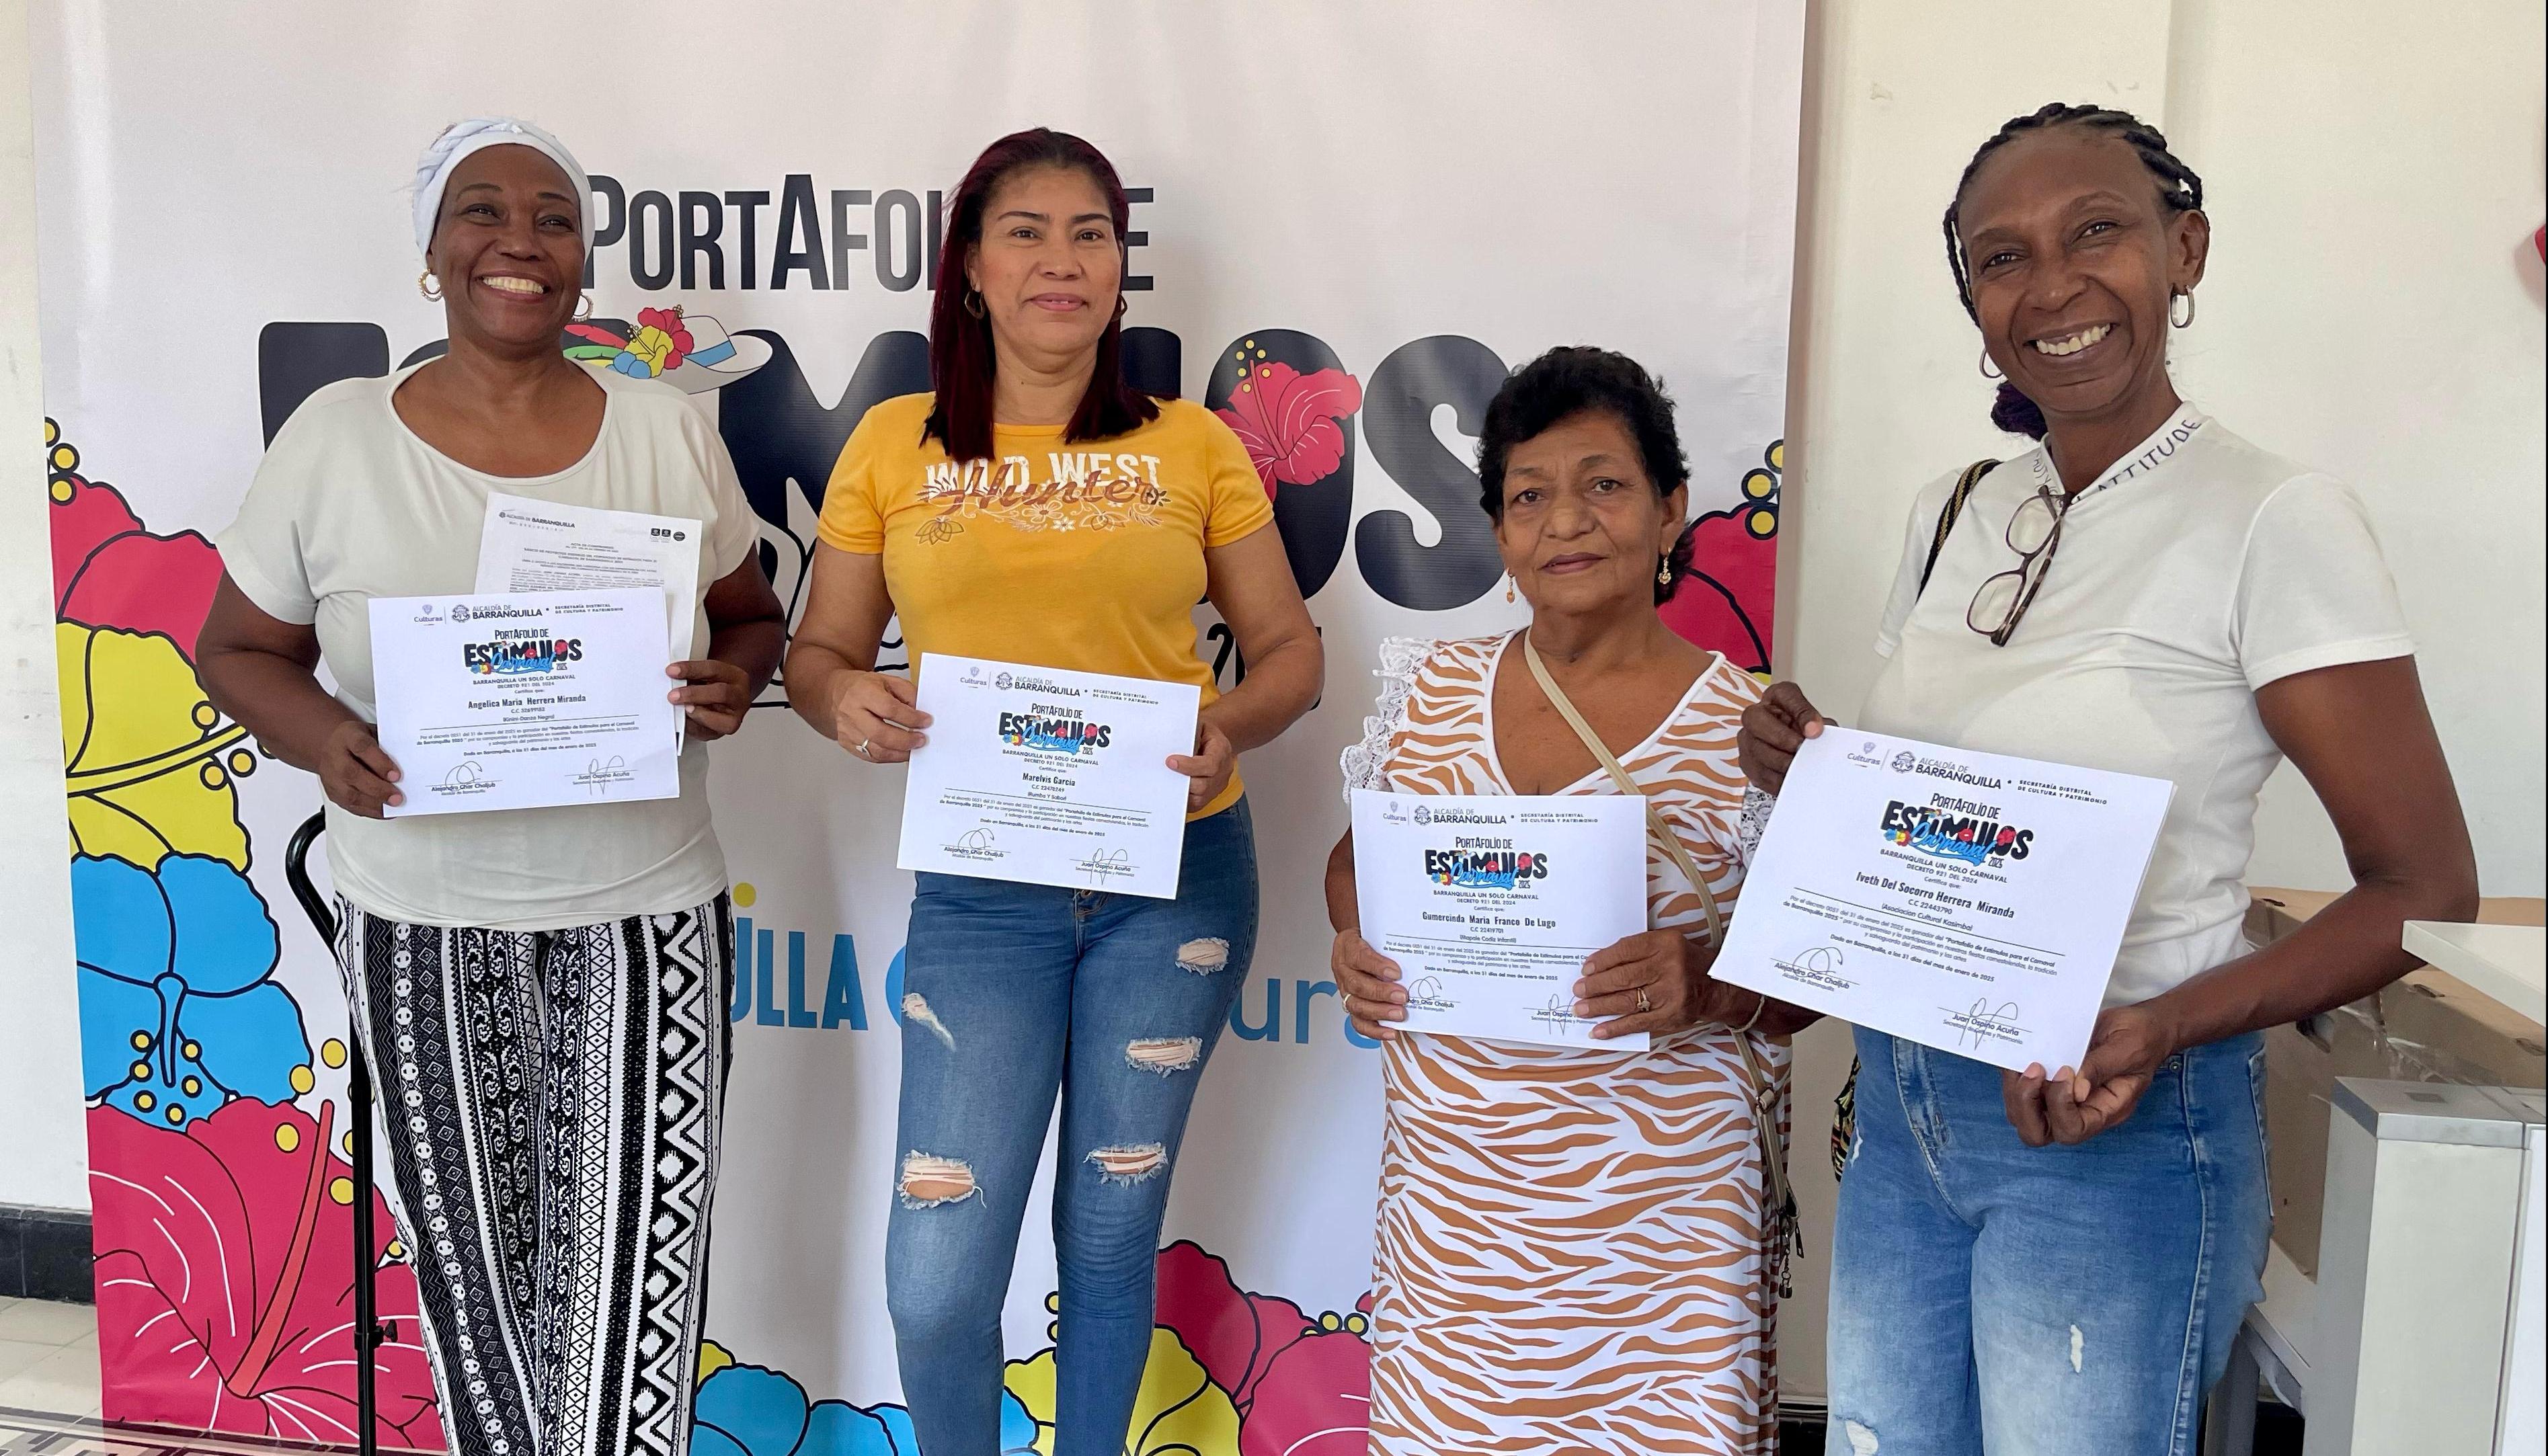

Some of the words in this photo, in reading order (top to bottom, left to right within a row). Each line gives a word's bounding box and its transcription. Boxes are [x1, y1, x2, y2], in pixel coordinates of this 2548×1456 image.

[583, 173, 943, 292] PORTAFO
[2098, 419, 2202, 491] ATTITUDE
[925, 455, 1030, 499] WILD
[1047, 452, 1160, 489] WEST
[939, 463, 1158, 516] Hunter
[471, 603, 502, 612] ALCALDÍA
[472, 608, 543, 619] BARRANQUILLA
[539, 628, 549, 637] DE
[959, 676, 987, 686] Culturas
[1014, 676, 1043, 685] ALCALDÍA
[1014, 681, 1080, 697] BARRANQUILLA
[467, 700, 500, 710] Angelica
[502, 698, 522, 706] Maria
[526, 696, 555, 704] Herrera
[557, 694, 586, 703] Miranda
[1073, 709, 1083, 719] DE
[1002, 748, 1043, 758] BARRANQUILLA
[1070, 757, 1099, 766] CARNAVAL
[1847, 752, 1880, 765] Culturas
[1917, 757, 1955, 770] ALCALDÍA
[1955, 764, 1969, 773] DE
[1022, 772, 1051, 783] Marelvis
[1915, 763, 2001, 789] BARRANQUILLA
[2019, 779, 2057, 790] SECRETARÍA
[2058, 786, 2092, 796] DISTRITAL
[2027, 787, 2057, 796] CULTURA
[2065, 793, 2107, 805] PATRIMONIO
[1382, 812, 1406, 821] Culturas
[1433, 807, 1464, 815] ALCALDÍA
[1433, 813, 1507, 824] BARRANQUILLA
[1986, 805, 2001, 819] DE
[1502, 838, 1513, 849] DE
[1909, 821, 1999, 866] Carnaval
[1880, 848, 1933, 866] BARRANQUILLA
[1934, 861, 1947, 869] UN
[1948, 864, 1968, 874] SOLO
[1968, 869, 2007, 883] CARNAVAL
[1987, 856, 2005, 868] 2025
[1905, 862, 1934, 874] DECRETO
[1948, 873, 1960, 881] DEL
[1960, 876, 1978, 884] 2024
[1433, 889, 1476, 897] BARRANQUILLA
[1856, 871, 1879, 886] Iveth
[1880, 877, 1897, 890] Del
[1897, 881, 1934, 899] Socorro
[1935, 891, 1972, 908] Herrera
[1976, 900, 2014, 918] Miranda
[1919, 901, 1952, 914] 22443790
[1422, 911, 1465, 923] Gumercinda
[1469, 914, 1490, 924] Maria
[1494, 916, 1520, 926] Franco
[1524, 917, 1535, 926] De
[1537, 917, 1556, 929] Lugo
[1773, 961, 1807, 977] Alejandro
[1806, 971, 1825, 981] Char
[1952, 1012, 1970, 1024] Juan
[1970, 1017, 1996, 1032] Ospino
